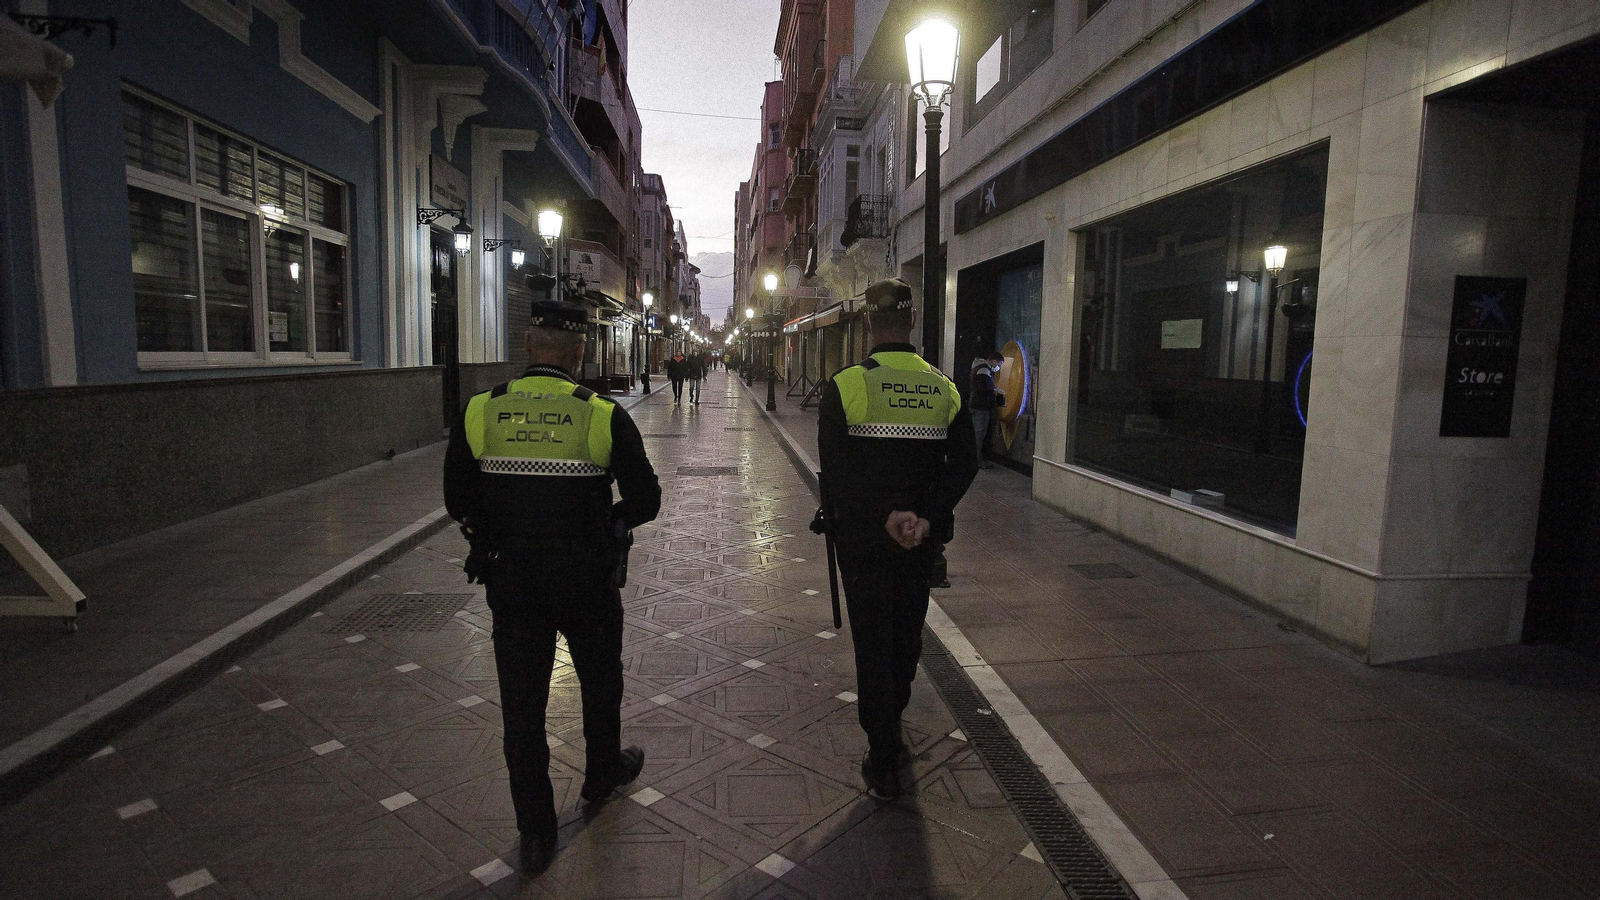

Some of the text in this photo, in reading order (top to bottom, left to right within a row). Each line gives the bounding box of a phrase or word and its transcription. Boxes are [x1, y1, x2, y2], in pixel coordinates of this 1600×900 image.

[1454, 331, 1514, 347] CaixaBank
[1458, 367, 1504, 384] Store
[881, 382, 942, 396] POLICIA
[889, 397, 933, 410] LOCAL
[497, 411, 574, 426] POLICIA
[505, 430, 563, 443] LOCAL
